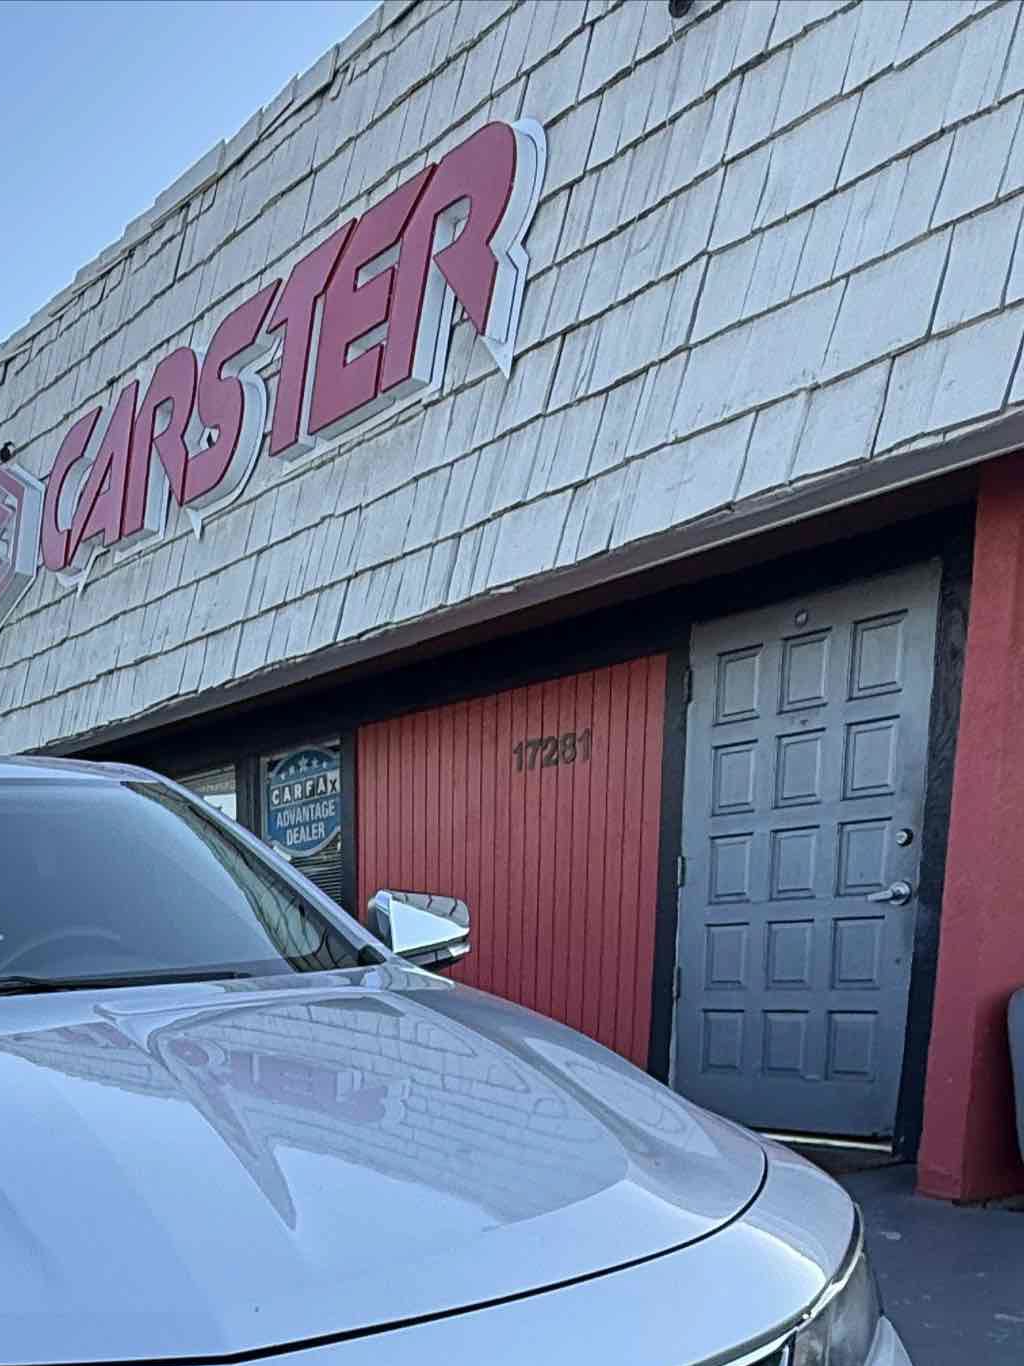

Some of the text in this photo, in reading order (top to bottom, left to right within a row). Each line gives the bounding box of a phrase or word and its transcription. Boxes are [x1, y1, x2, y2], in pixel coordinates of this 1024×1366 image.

[41, 120, 518, 572] CARSTER
[513, 728, 592, 772] 17281
[272, 773, 338, 805] CARFAX
[276, 800, 336, 830] ADVANTAGE
[286, 821, 325, 846] DEALER
